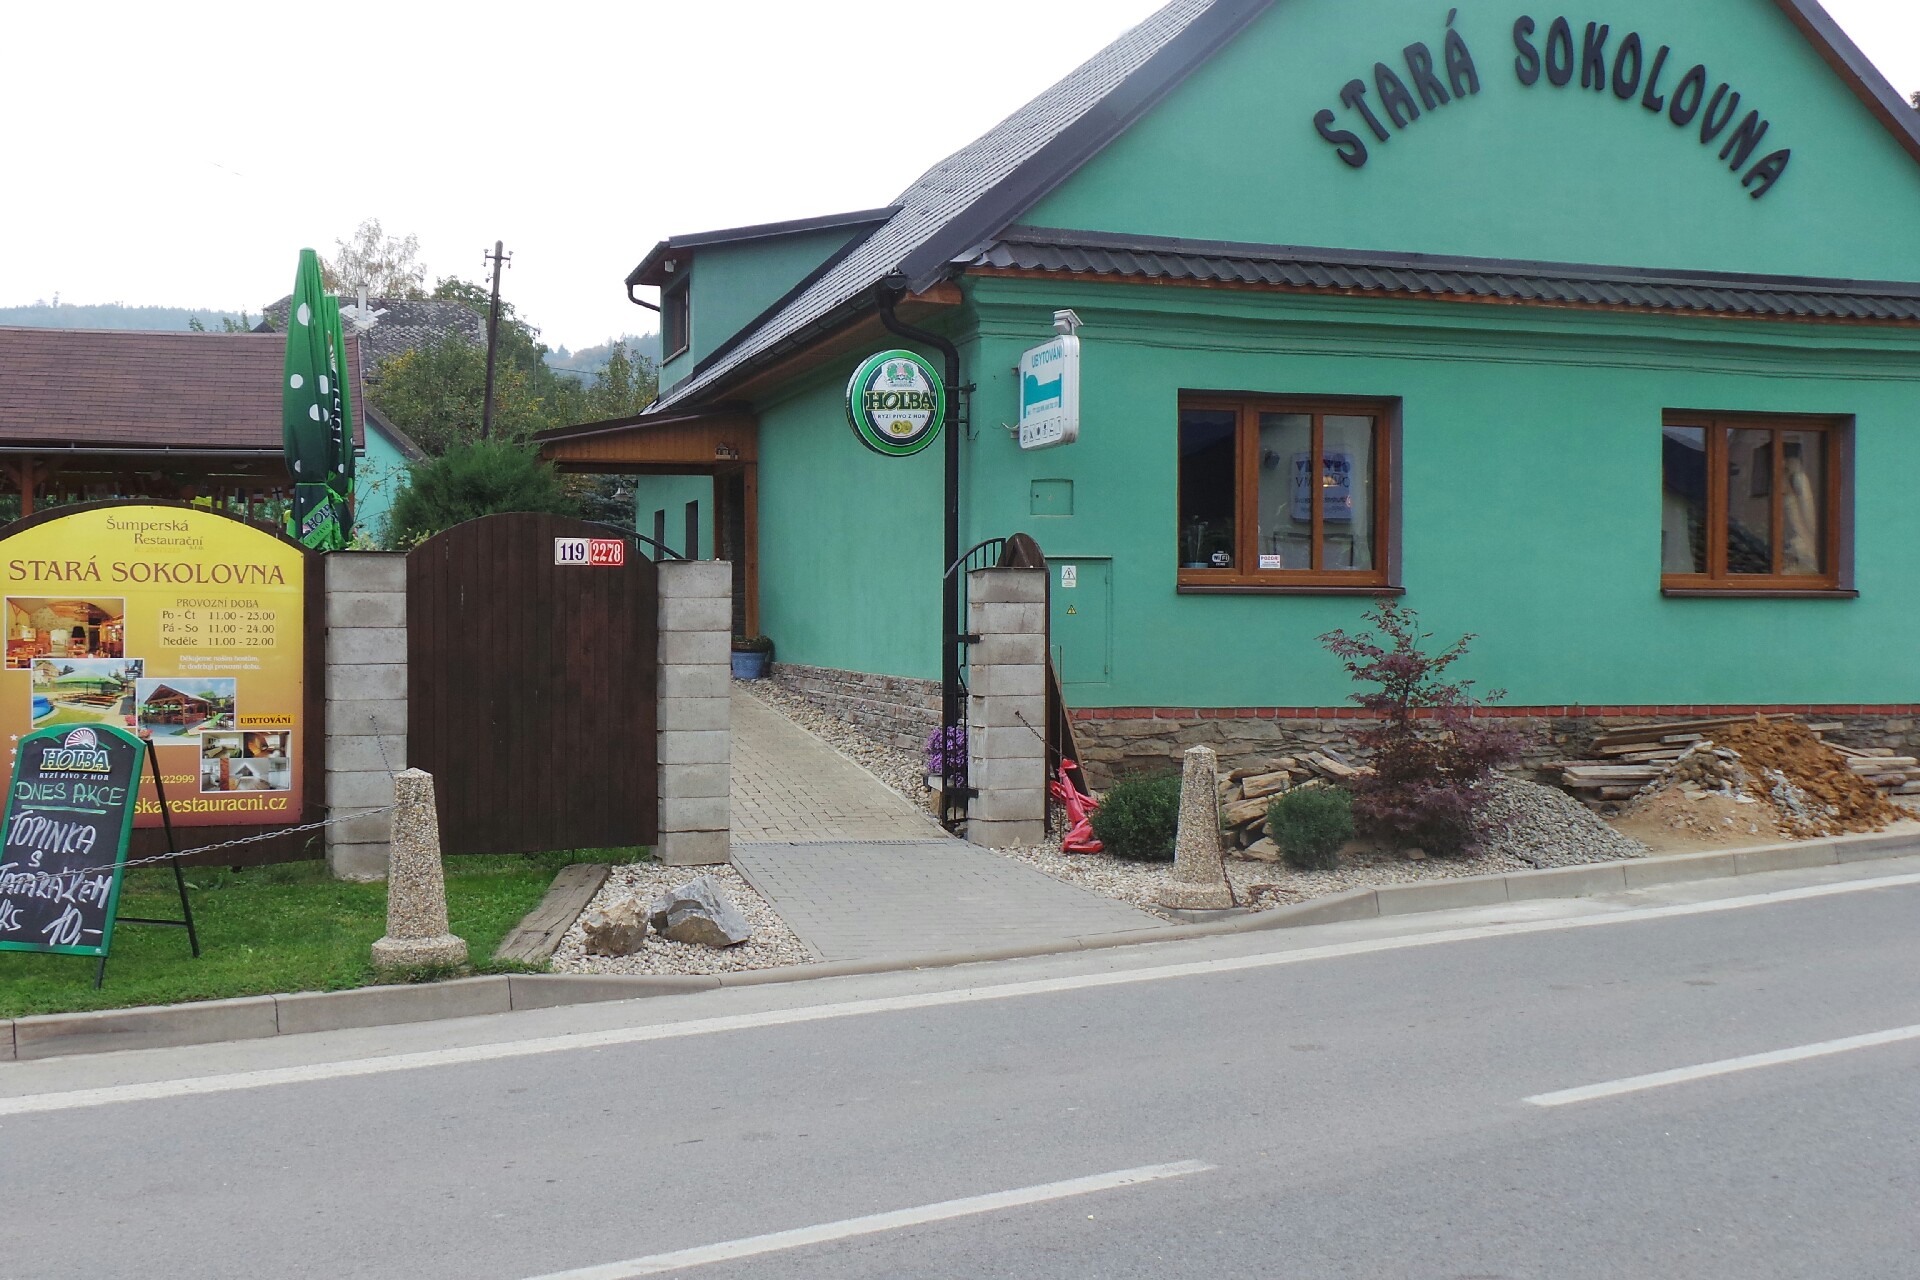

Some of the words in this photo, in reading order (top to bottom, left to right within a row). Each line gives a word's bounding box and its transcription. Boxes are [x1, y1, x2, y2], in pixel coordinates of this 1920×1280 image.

[1313, 8, 1481, 168] STARÁ
[1513, 15, 1791, 200] SOKOLOVNA
[865, 390, 936, 411] HOLBA
[106, 515, 189, 533] Šumperská
[134, 532, 204, 546] Restaurační
[560, 542, 585, 561] 119
[592, 543, 621, 562] 2278
[8, 555, 102, 582] STARÁ
[111, 561, 286, 585] SOKOLOVNA
[176, 597, 227, 608] PROVOZNÍ
[230, 599, 259, 608] DOBA
[162, 610, 175, 620] Po
[184, 609, 196, 620] Čt
[209, 611, 237, 621] 11.00
[247, 612, 275, 621] 23.00
[162, 623, 175, 633] Pá
[185, 624, 199, 633] So
[209, 624, 237, 633] 11.00
[246, 624, 275, 633] 24.00
[163, 637, 198, 646] Neděle
[208, 637, 236, 646] 11.00
[246, 637, 274, 646] 22.00
[240, 714, 291, 724] UBYTOVÁNÍ
[40, 748, 112, 773] HOLBA
[140, 774, 195, 784] 77722999
[15, 781, 66, 801] DNES
[72, 783, 126, 807] AKCE
[6, 810, 97, 854] TOPINKA
